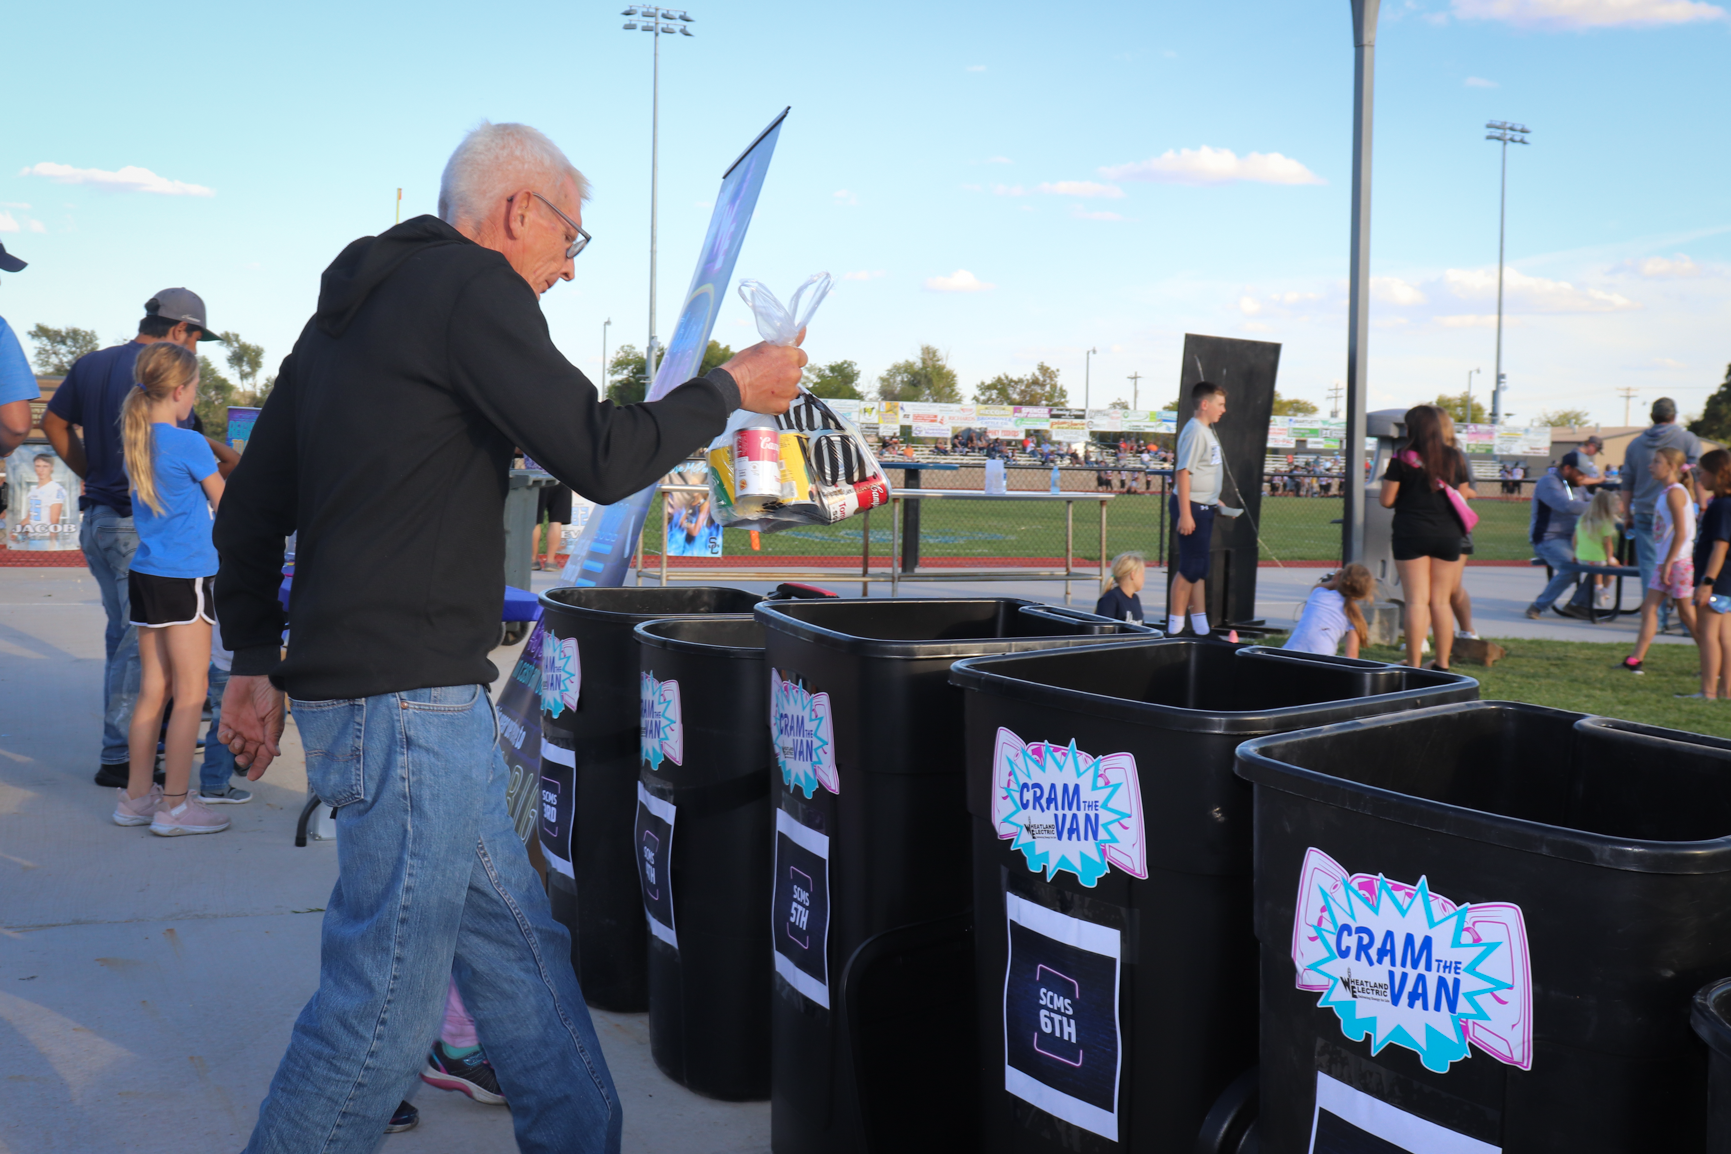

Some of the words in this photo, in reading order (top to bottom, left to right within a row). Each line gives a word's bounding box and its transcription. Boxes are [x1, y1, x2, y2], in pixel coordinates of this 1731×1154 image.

[12, 523, 77, 533] JACOB
[780, 712, 805, 738] CRAM
[792, 738, 813, 762] VAN
[1019, 782, 1081, 813] CRAM
[1082, 800, 1099, 811] THE
[1024, 823, 1055, 834] WHEATLAND
[1031, 829, 1055, 839] ELECTRIC
[1054, 813, 1099, 841] VAN
[793, 884, 810, 907] SCMS
[790, 901, 809, 931] 5TH
[1336, 923, 1432, 972] CRAM
[1434, 959, 1462, 975] THE
[1340, 976, 1389, 993] WHEATLAND
[1351, 985, 1388, 998] ELECTRIC
[1388, 969, 1460, 1014] VAN
[1039, 987, 1073, 1015] SCMS
[1039, 1009, 1077, 1044] 6TH
